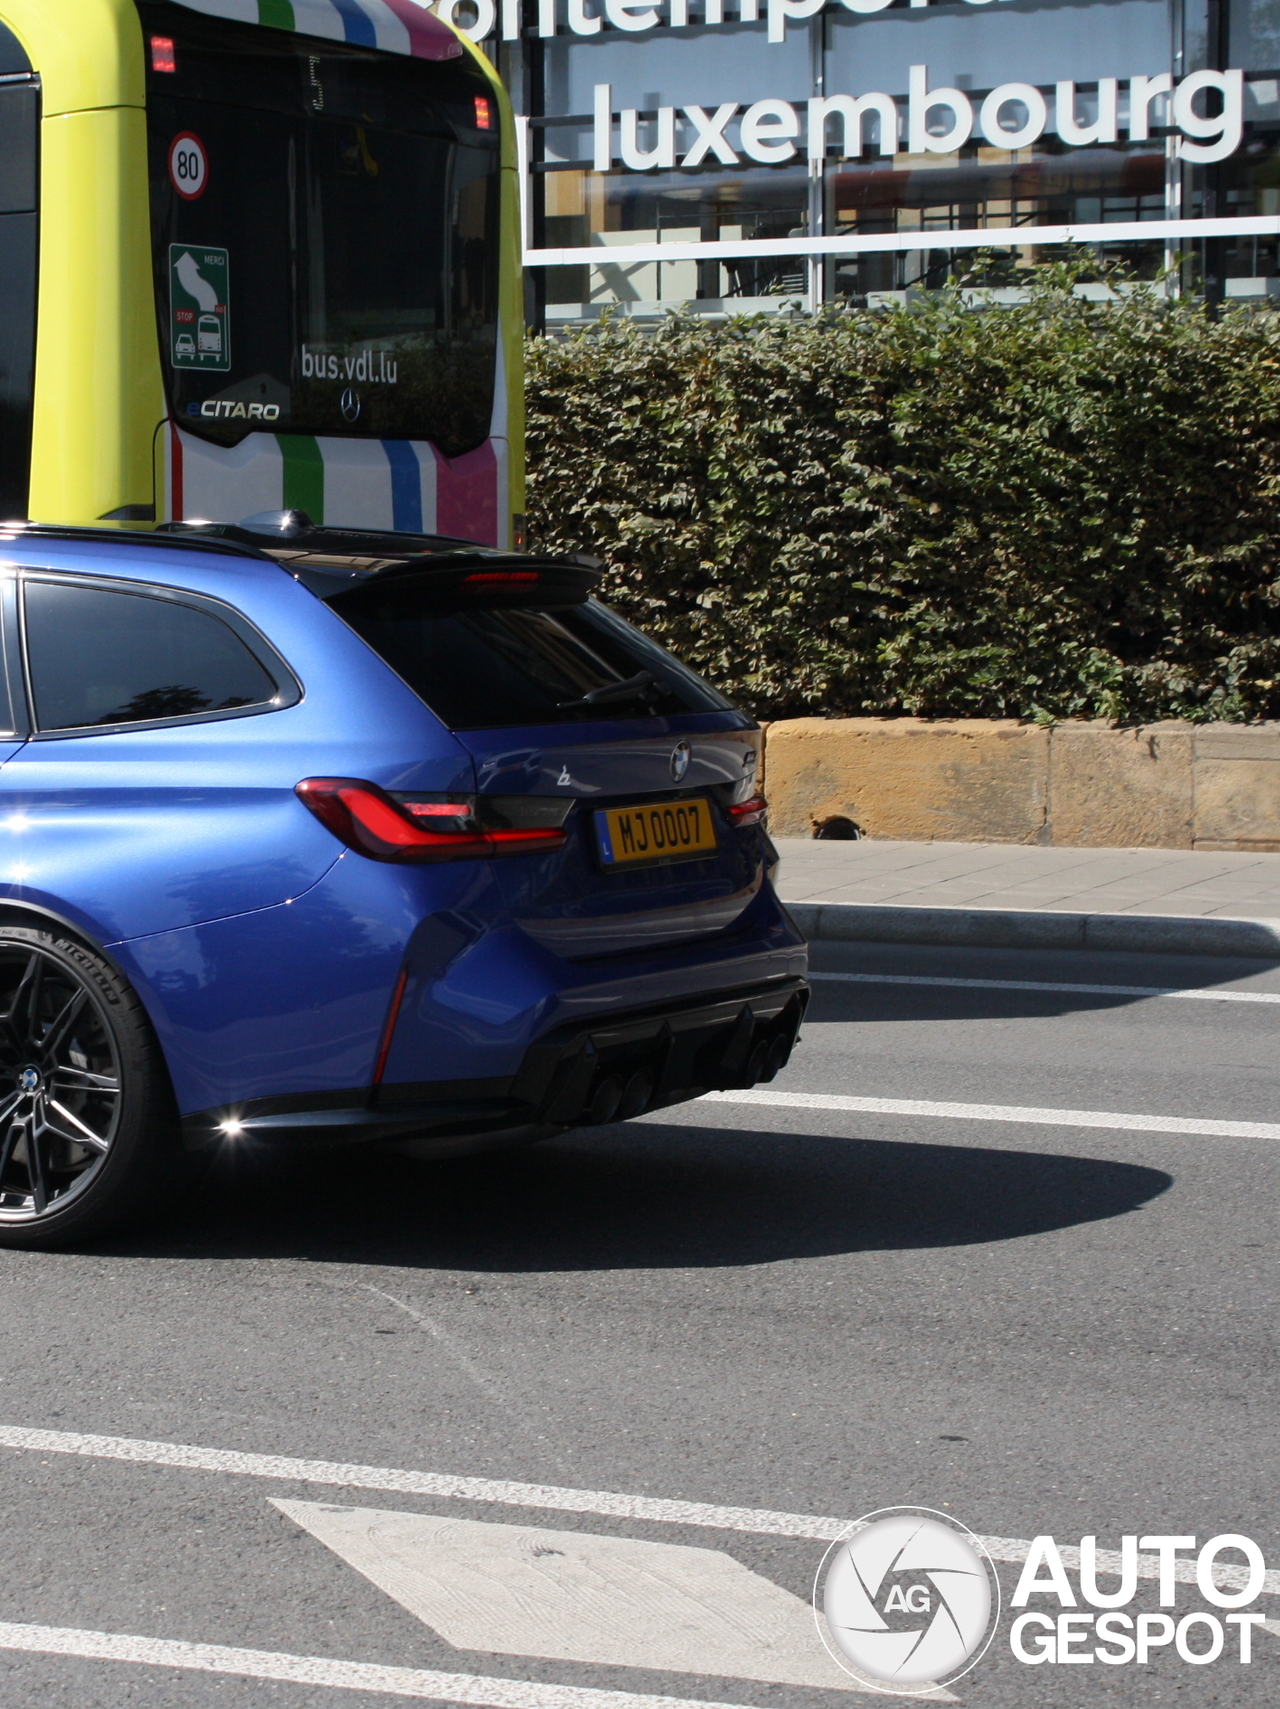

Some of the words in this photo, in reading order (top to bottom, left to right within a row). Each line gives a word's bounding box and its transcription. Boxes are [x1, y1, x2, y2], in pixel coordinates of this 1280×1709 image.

[593, 65, 1243, 171] luxembourg
[178, 151, 198, 180] 80
[204, 255, 224, 265] MERCI
[176, 312, 193, 321] STOP
[301, 343, 397, 384] bus.vdl.lu
[186, 400, 280, 421] eCITARO
[603, 842, 610, 855] L
[54, 938, 117, 1002] MICHELIN
